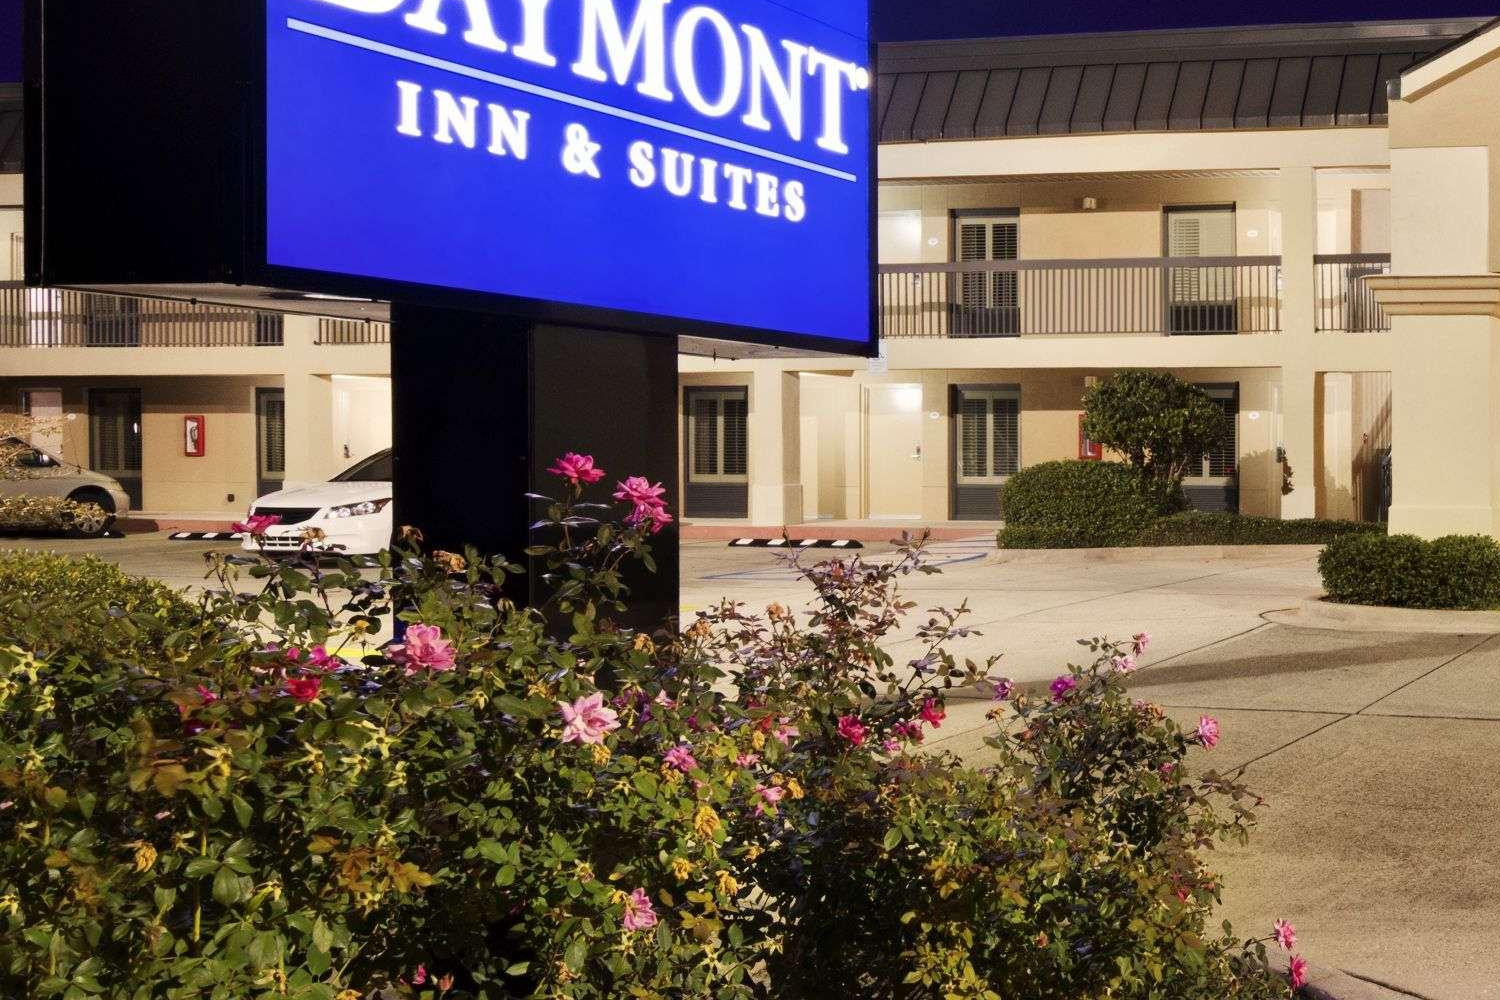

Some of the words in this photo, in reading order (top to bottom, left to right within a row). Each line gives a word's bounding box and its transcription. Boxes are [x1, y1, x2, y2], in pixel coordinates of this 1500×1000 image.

[395, 79, 531, 161] INN
[561, 122, 602, 180] &
[628, 140, 807, 223] SUITES
